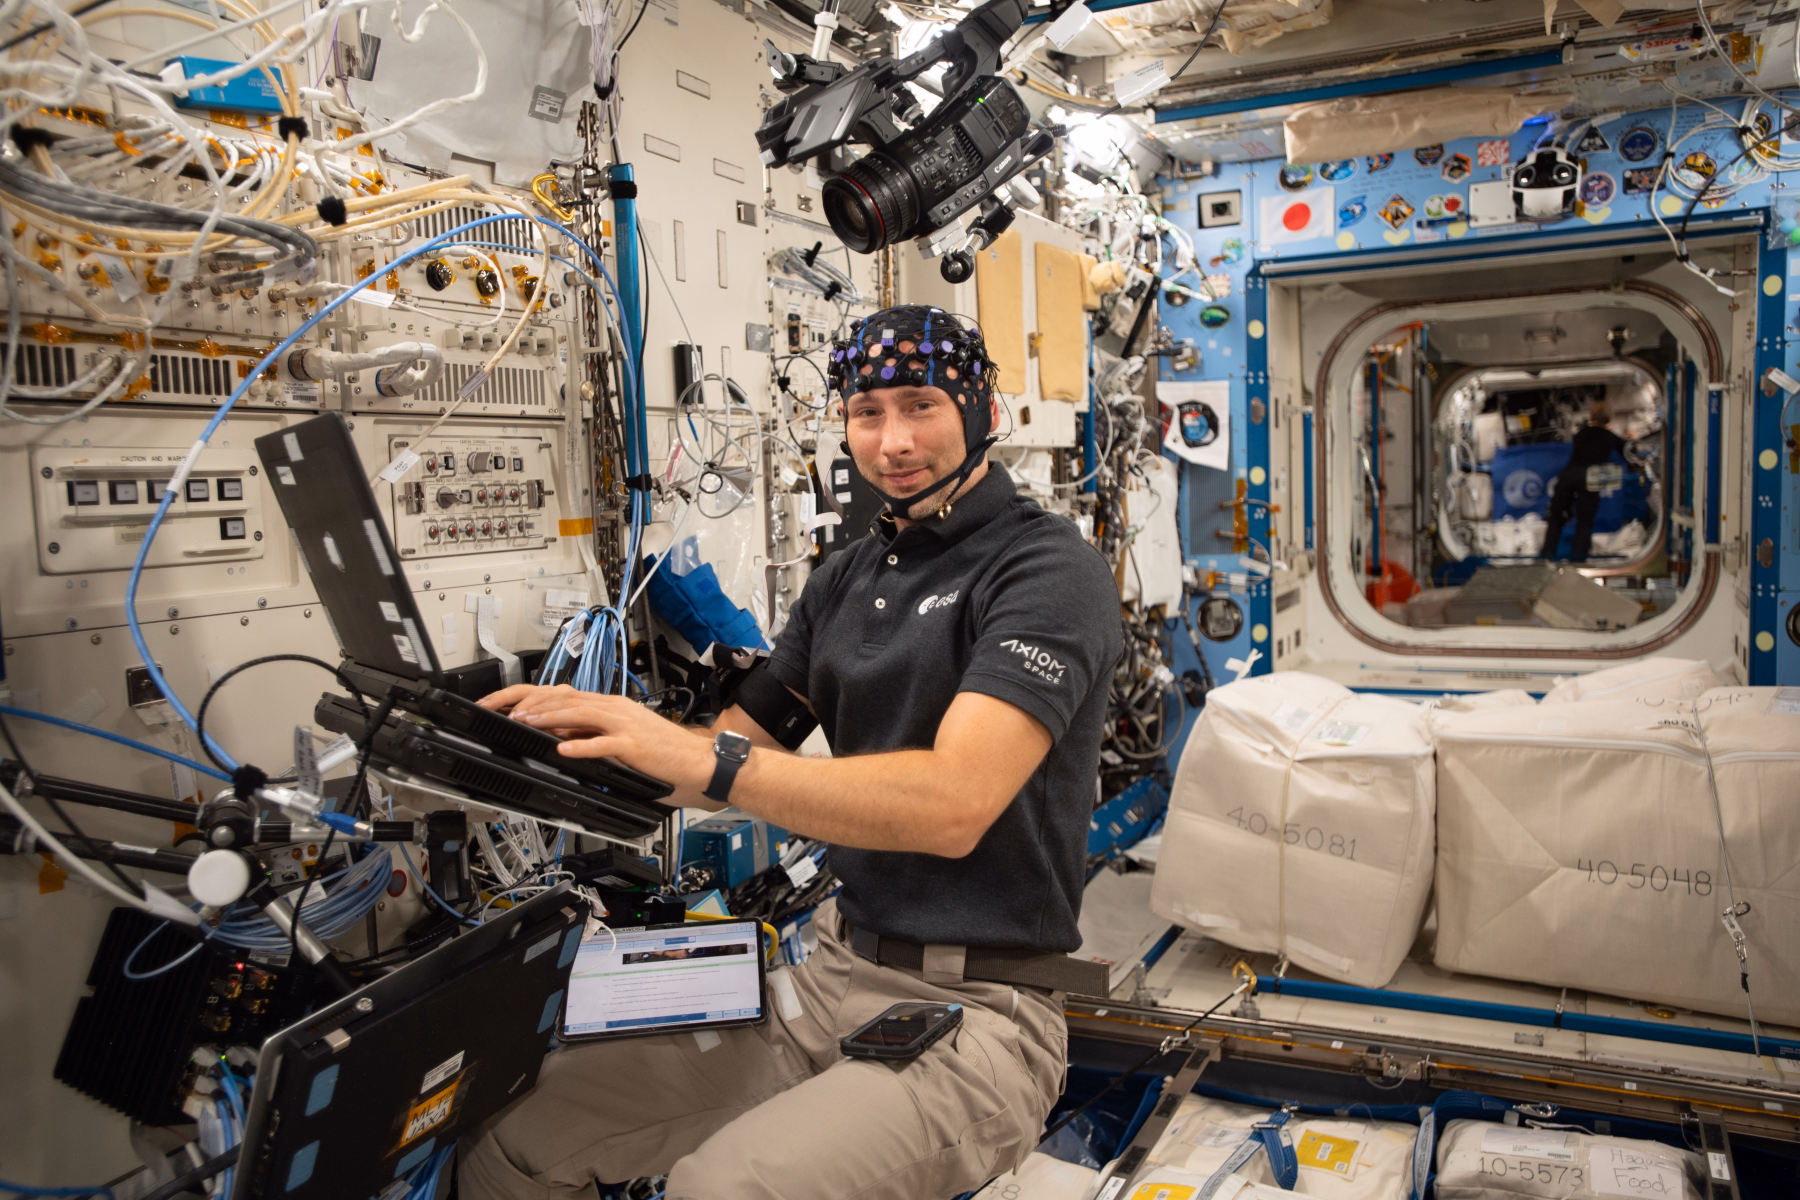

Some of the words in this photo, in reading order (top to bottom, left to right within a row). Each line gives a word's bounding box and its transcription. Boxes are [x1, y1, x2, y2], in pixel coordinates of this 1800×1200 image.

[994, 155, 1012, 173] Canon
[935, 590, 959, 608] esa
[1000, 639, 1066, 677] AXIOM
[1024, 661, 1060, 684] SPACE
[1226, 806, 1356, 861] 4.0-5081
[1577, 858, 1712, 896] 4.0-5048
[508, 1072, 527, 1094] ThinkPad
[406, 1108, 446, 1141] JAXA
[1478, 1156, 1584, 1187] 1.0-5573
[1613, 1166, 1675, 1194] Food
